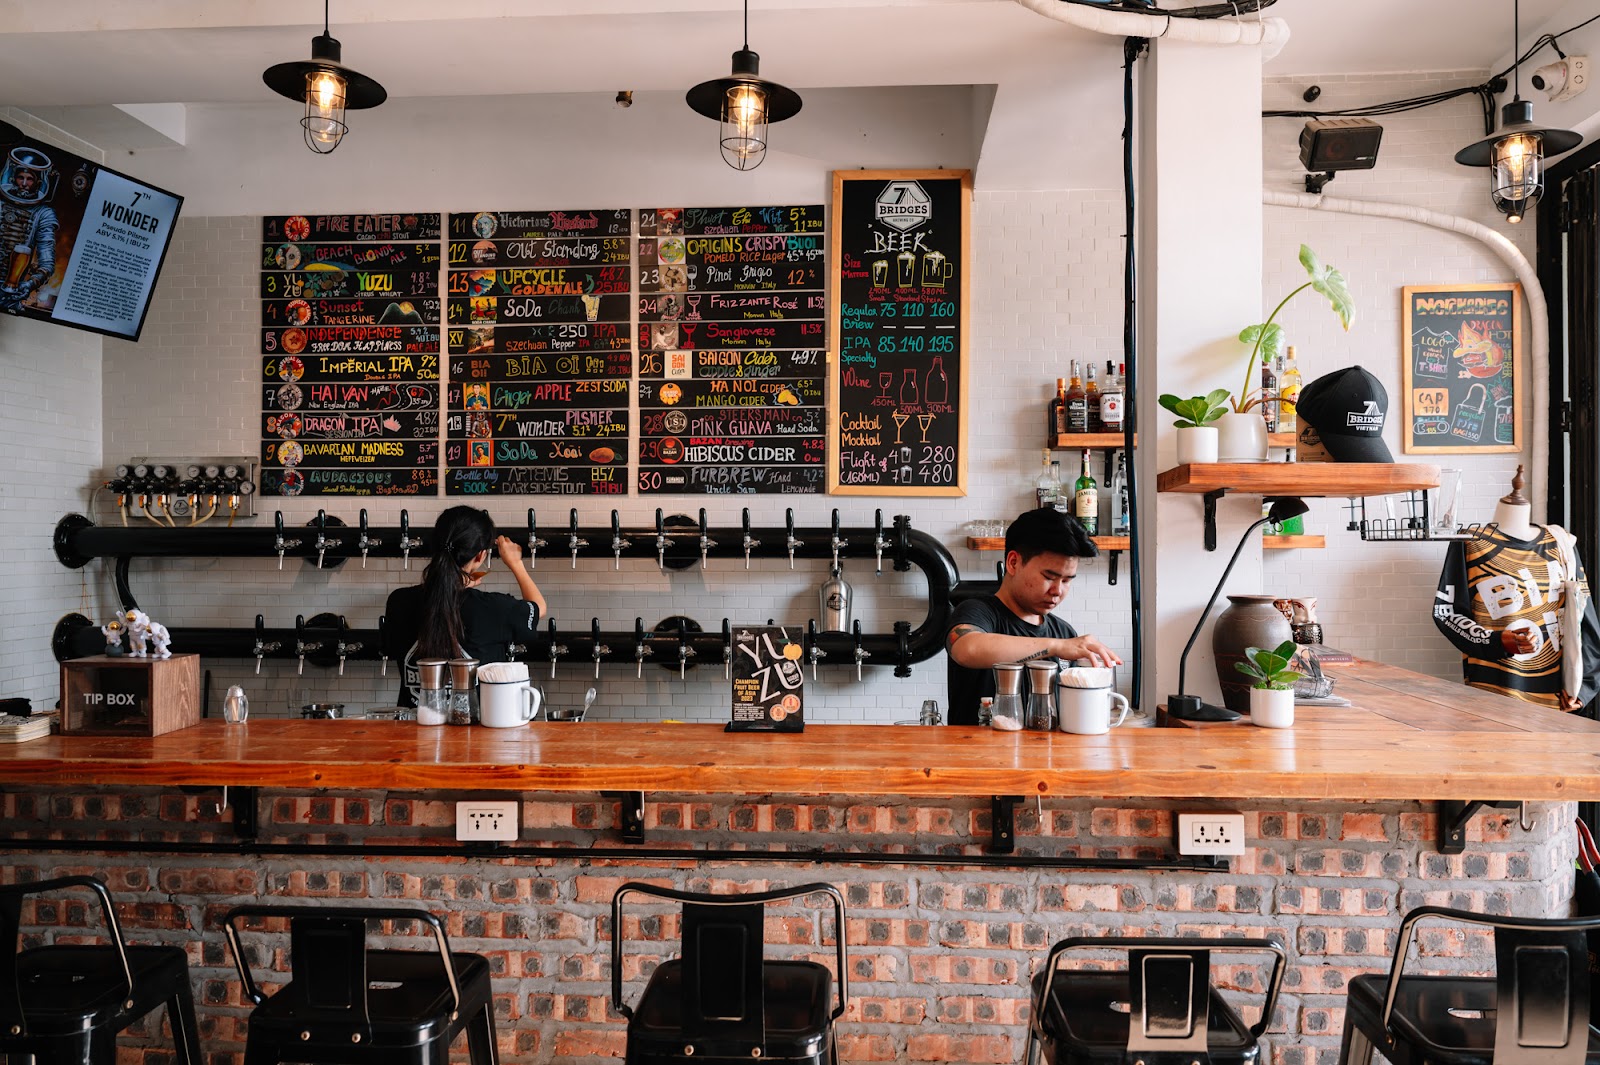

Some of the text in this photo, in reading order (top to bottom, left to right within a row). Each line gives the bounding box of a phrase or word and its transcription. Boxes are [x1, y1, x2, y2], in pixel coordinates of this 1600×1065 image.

[894, 188, 905, 204] 7
[101, 200, 159, 234] WONDER
[880, 205, 928, 215] BRIDGES
[316, 216, 349, 232] FIRE
[354, 215, 401, 232] EATER
[453, 219, 466, 233] 11
[641, 213, 657, 228] 21
[96, 228, 110, 238] ABV
[129, 240, 142, 249] IBU
[142, 243, 150, 251] 27
[102, 223, 149, 242] Pseudo Pilsner
[542, 239, 600, 260] Standing
[640, 243, 652, 255] 22
[687, 237, 743, 255] ORIGINS
[745, 236, 787, 251] CRISPY
[870, 231, 932, 254] BEER
[316, 245, 352, 262] BEACH
[354, 244, 394, 265] BLONDE
[390, 253, 407, 265] ALE
[449, 243, 467, 263] 12
[704, 251, 786, 264] POMELO Lager
[357, 272, 392, 291] YUZU
[503, 269, 566, 285] UPCYCLE
[641, 270, 659, 284] 23
[706, 266, 732, 283] Pinot
[739, 265, 773, 283] Grigio
[267, 277, 276, 292] 3
[449, 273, 469, 293] 13
[512, 281, 583, 295] GOLDEN ALE
[320, 300, 364, 313] Sunset
[639, 300, 657, 313] 24
[710, 295, 770, 308] FRIZZANTE
[267, 304, 276, 319] 4
[448, 304, 463, 319] 14
[842, 302, 954, 321] Regular 75 110 160
[323, 315, 375, 324] TANGERINE
[843, 318, 874, 330] Brew
[306, 327, 402, 341] INDEPENDENCE
[559, 324, 617, 338] 250 IPA
[706, 323, 776, 340] Sangiovese
[266, 332, 276, 350] 5
[844, 336, 954, 352] IPA 85 140 195
[1422, 336, 1444, 346] LOGO
[389, 356, 414, 372] IPA
[421, 355, 436, 367] 9%
[640, 354, 662, 374] 26
[699, 351, 778, 365] SAIGON Cider
[841, 351, 877, 368] Specialty
[265, 359, 275, 376] 6
[452, 362, 463, 374] 16
[842, 367, 871, 388] Wine
[312, 385, 368, 402] HAI VAN
[710, 381, 729, 392] HA
[266, 390, 275, 407] 7
[448, 390, 460, 403] 17
[494, 381, 627, 409] Ginger APPLE ZEST SODA
[696, 395, 766, 406] MANGO CIDER
[1419, 393, 1443, 404] CAP
[324, 401, 346, 409] England
[305, 418, 380, 432] DRAGON IPA
[566, 410, 613, 425] PILSNER
[840, 412, 882, 432] Cocktail
[517, 421, 565, 436] WONDER
[692, 418, 725, 435] PINK
[729, 421, 773, 435] GUAVA
[797, 423, 819, 432] Soda
[842, 433, 882, 447] Mocktail
[266, 444, 275, 460] 9
[304, 443, 404, 456] BAVARIAN MADNESS
[448, 446, 461, 460] 19
[640, 442, 657, 458] 29
[684, 446, 796, 462] HIBISCUS CIDER
[841, 450, 876, 473] Flight
[889, 449, 898, 464] 4
[918, 446, 955, 464] 280
[310, 471, 392, 484] AUDACIOUS
[455, 470, 482, 480] Bottle
[508, 467, 569, 481] ARTEMIS
[639, 472, 661, 490] 30
[691, 466, 771, 484] FURBREW
[891, 470, 899, 482] 7
[919, 464, 953, 483] 480
[705, 483, 756, 494] Uncle Sam
[83, 693, 135, 705] TIP BOX
